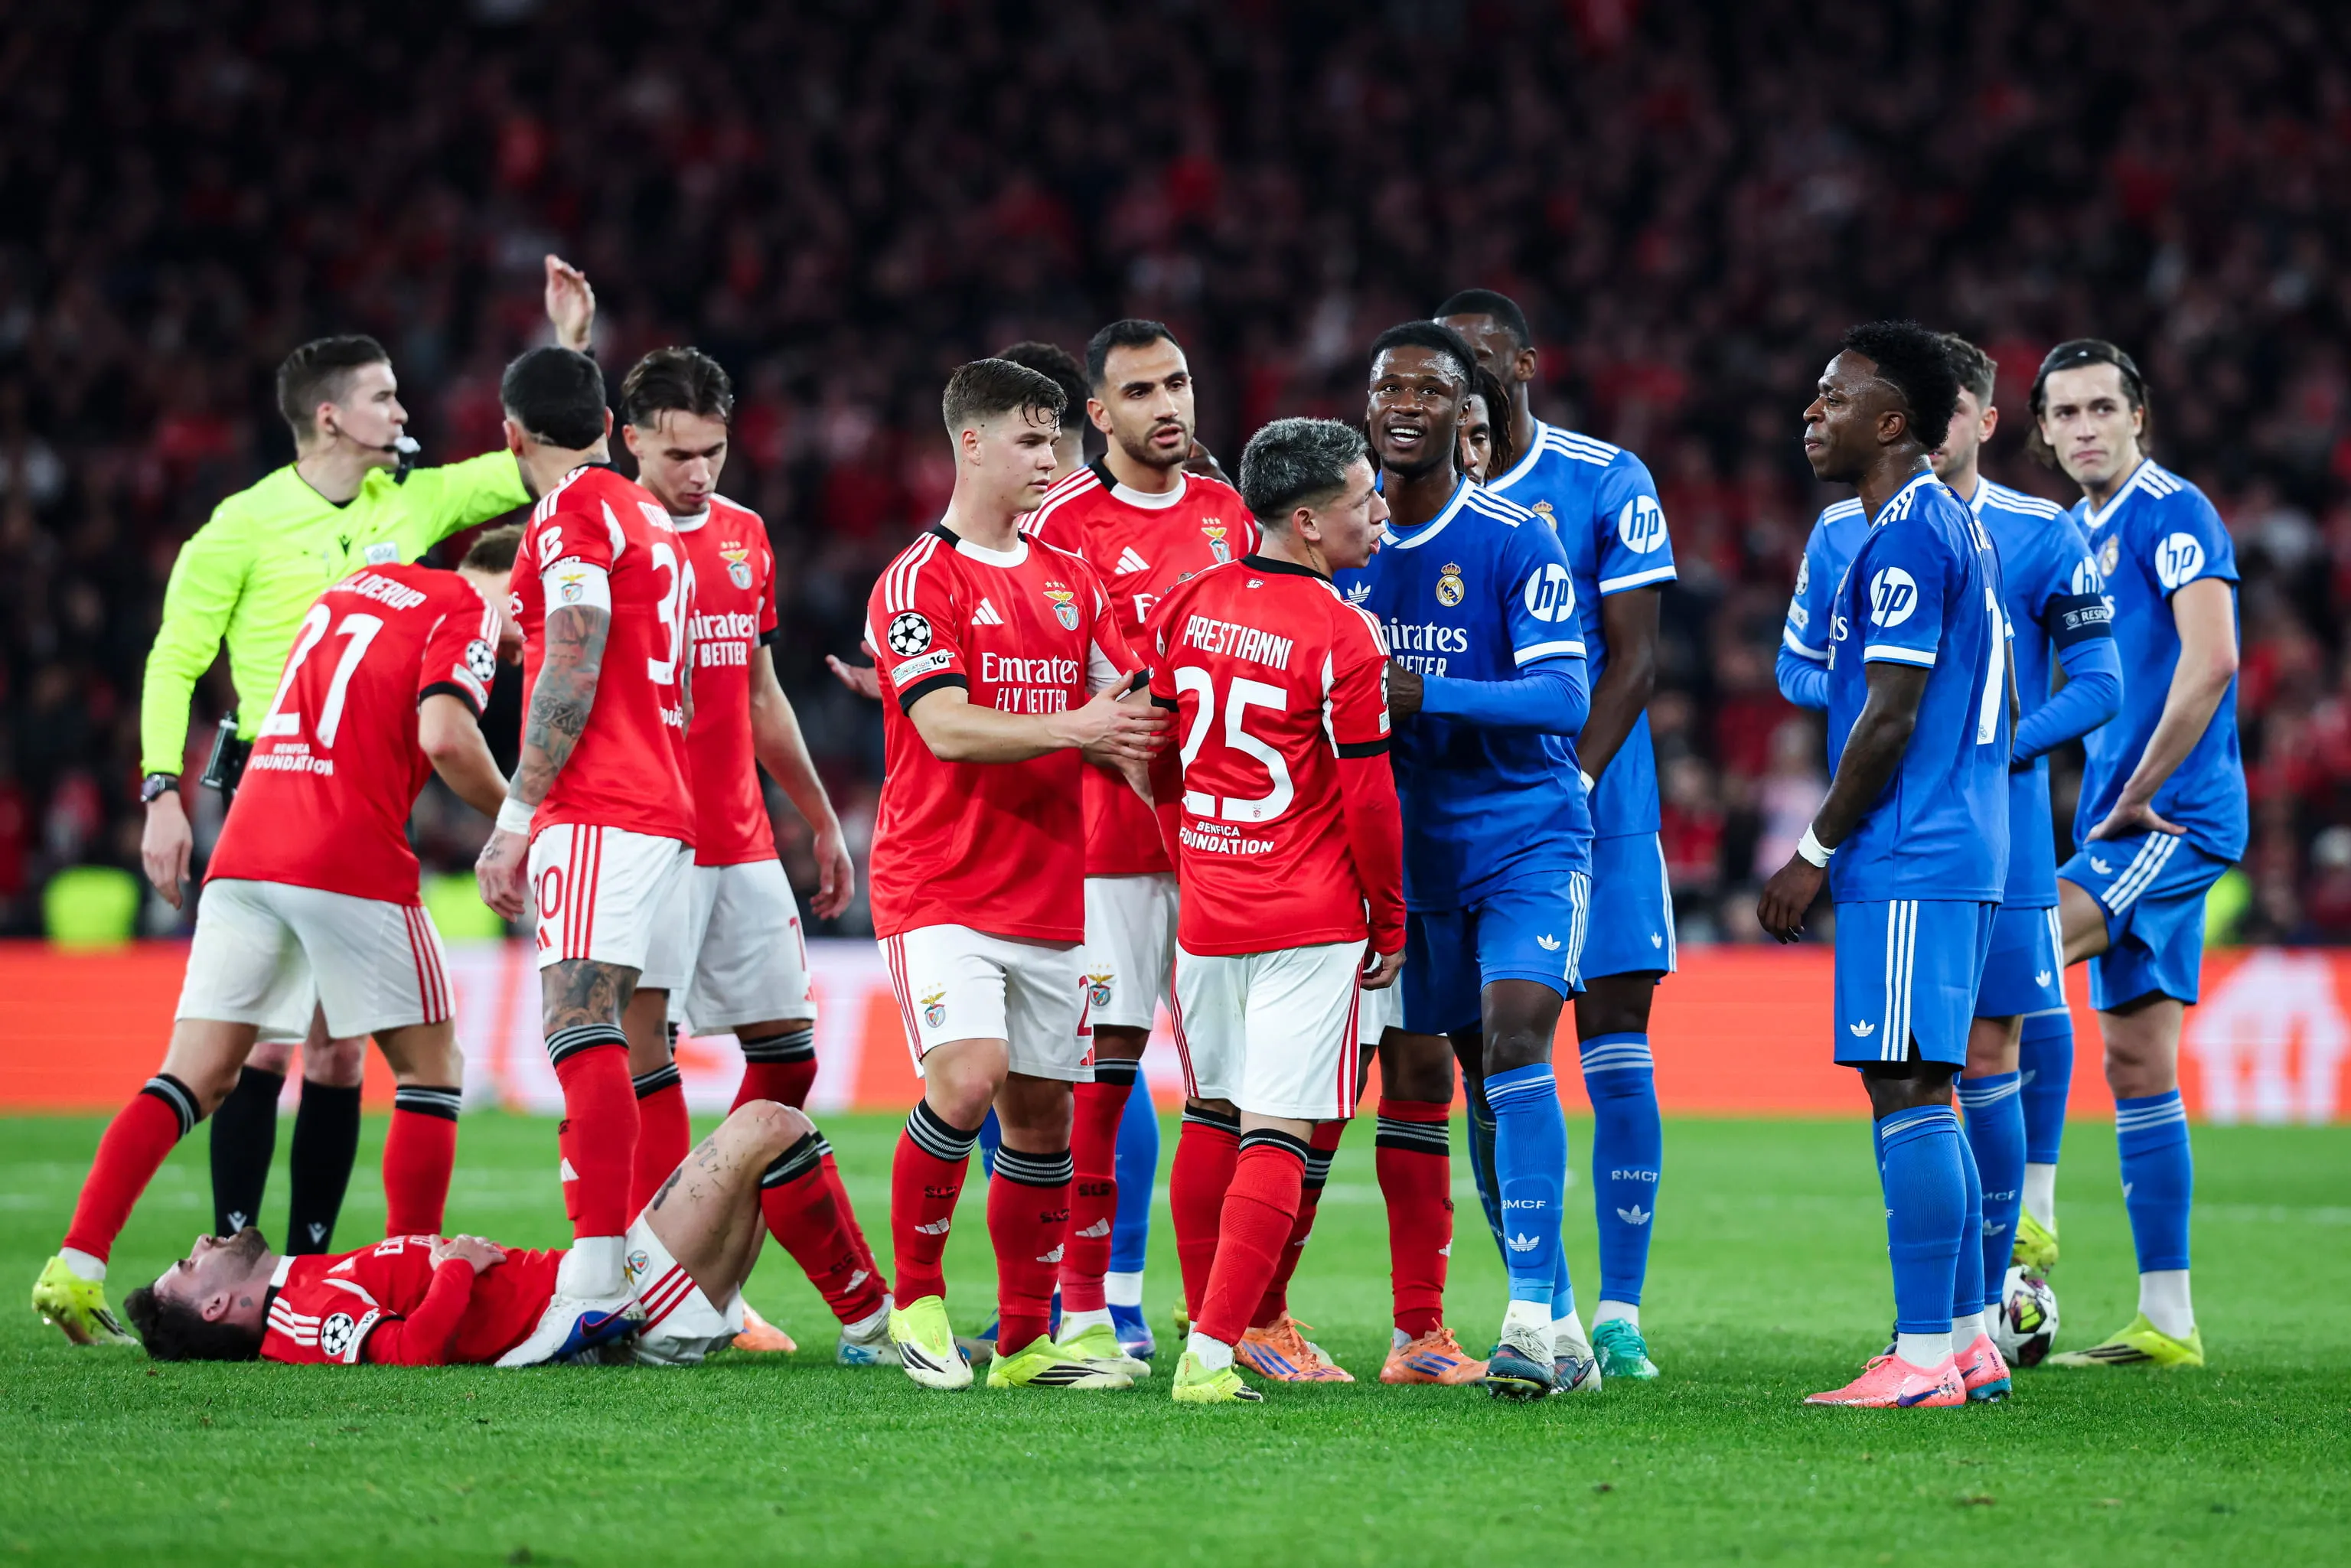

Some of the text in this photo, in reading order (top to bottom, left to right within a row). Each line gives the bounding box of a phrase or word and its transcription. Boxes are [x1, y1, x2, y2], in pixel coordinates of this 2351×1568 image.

[1623, 495, 1662, 554] hp
[2160, 533, 2199, 589] hp
[647, 542, 696, 687] 30
[1529, 563, 1572, 623] hp
[1872, 567, 1916, 628] hp
[690, 609, 755, 639] irates
[1182, 614, 1293, 671] PRESTIANNI
[257, 604, 383, 749] 27
[701, 641, 748, 667] BETTER
[996, 687, 1023, 712] FLY
[1173, 666, 1294, 823] 25
[1179, 826, 1275, 855] FOUNDATION
[1196, 820, 1241, 837] BENFICA
[1612, 1169, 1658, 1183] RMCF
